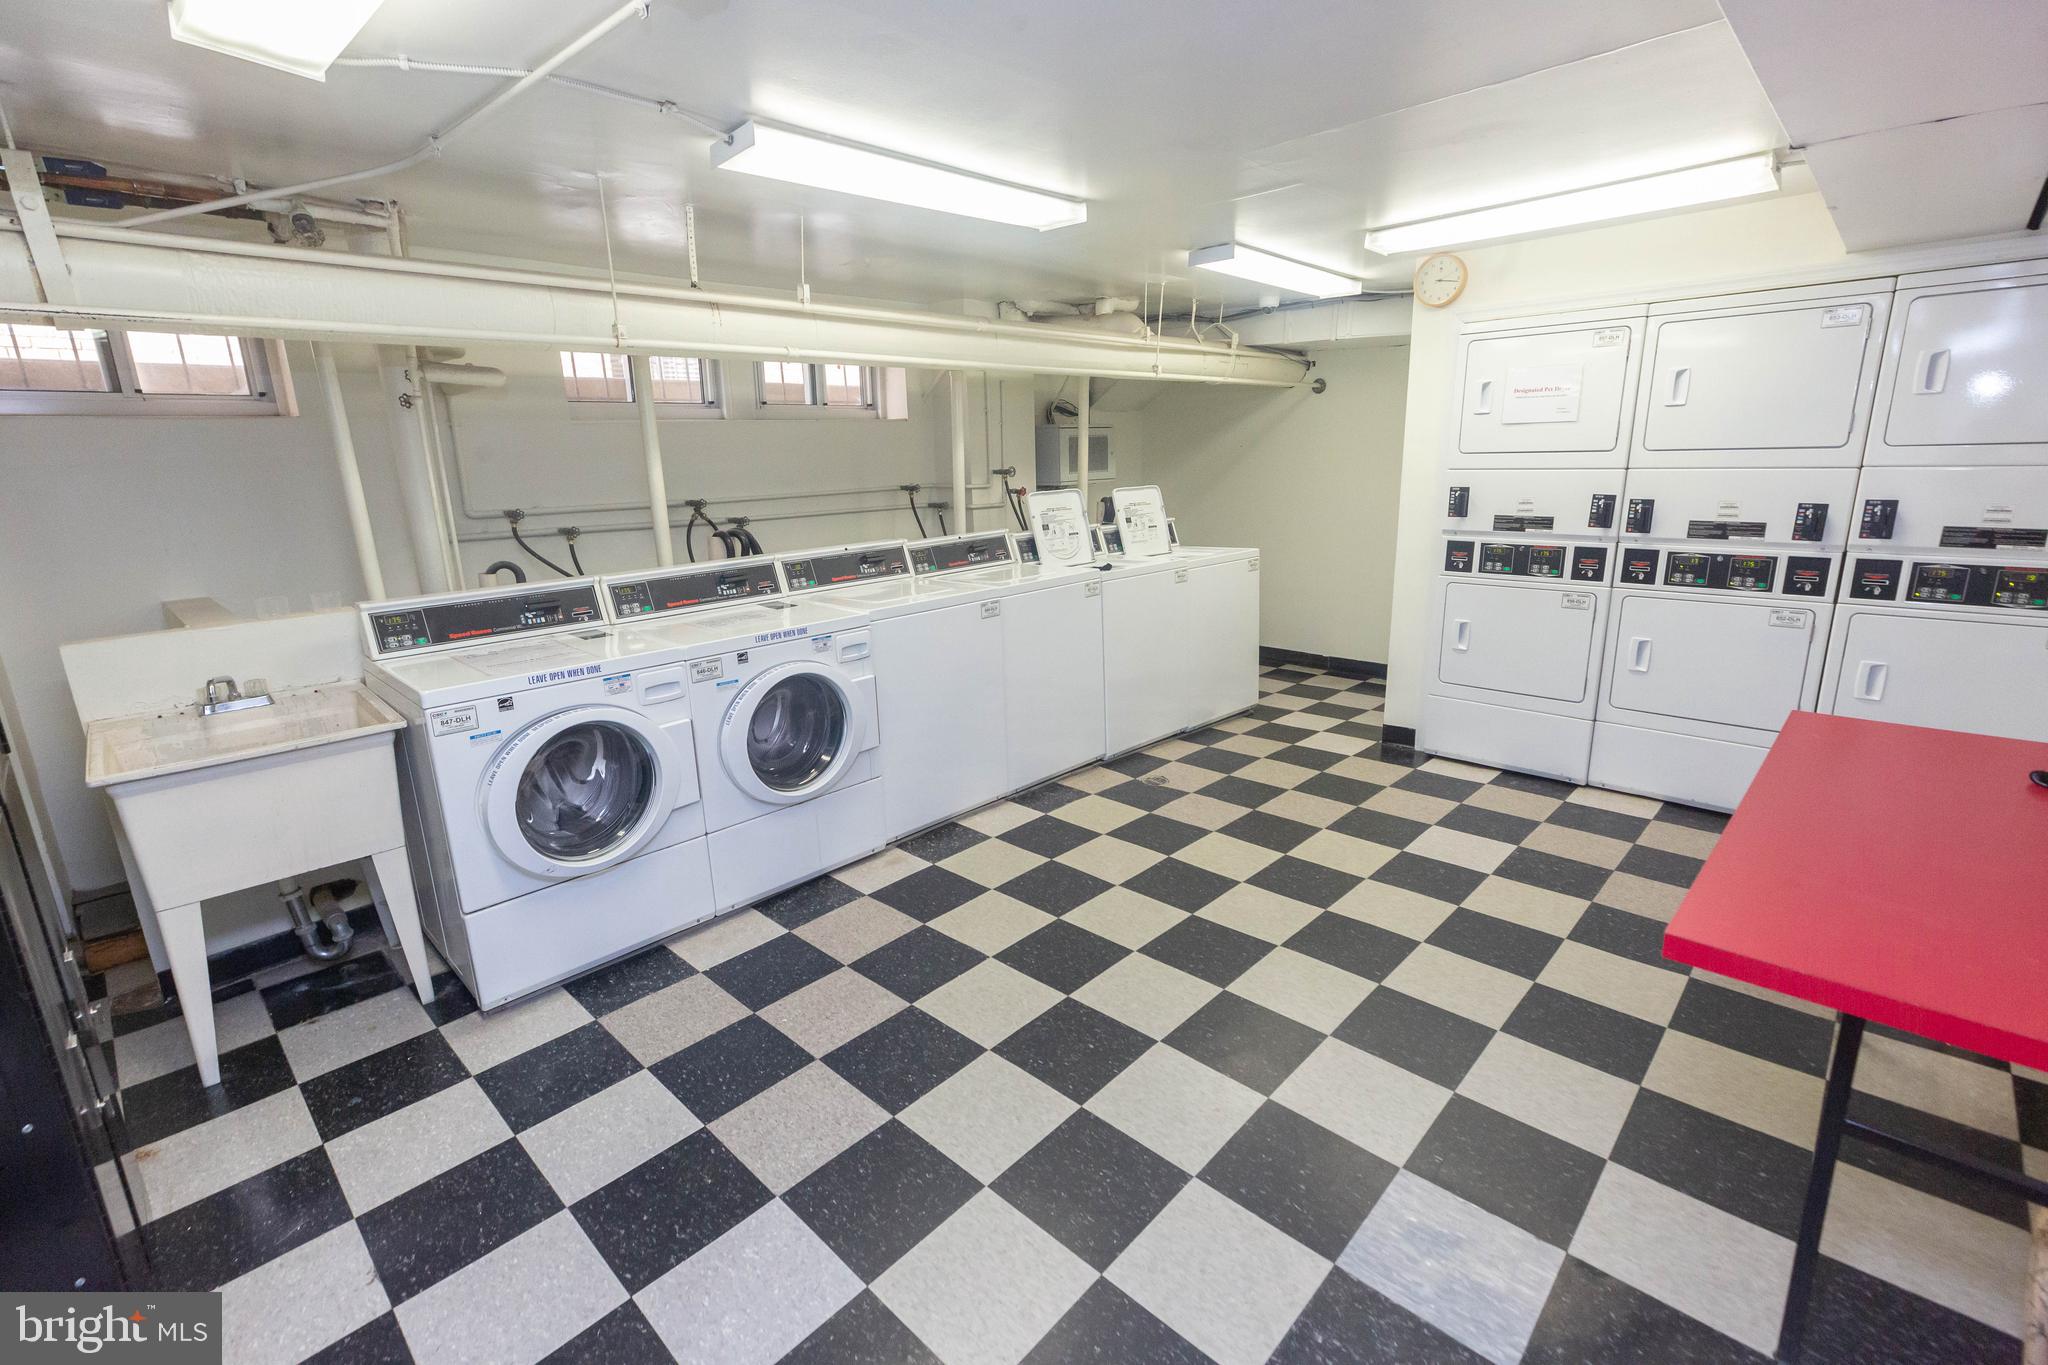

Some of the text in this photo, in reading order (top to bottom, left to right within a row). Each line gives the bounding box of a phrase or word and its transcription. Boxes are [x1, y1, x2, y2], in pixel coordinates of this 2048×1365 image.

[1513, 386, 1543, 394] Designated
[755, 627, 808, 643] LEAVE OPEN WHEN DONE
[528, 665, 602, 685] LEAVE OPEN WHEN DONE
[440, 714, 472, 727] 847-DLH
[488, 769, 498, 786] LEAVE
[496, 756, 507, 770] OPEN
[505, 742, 520, 756] WHEN
